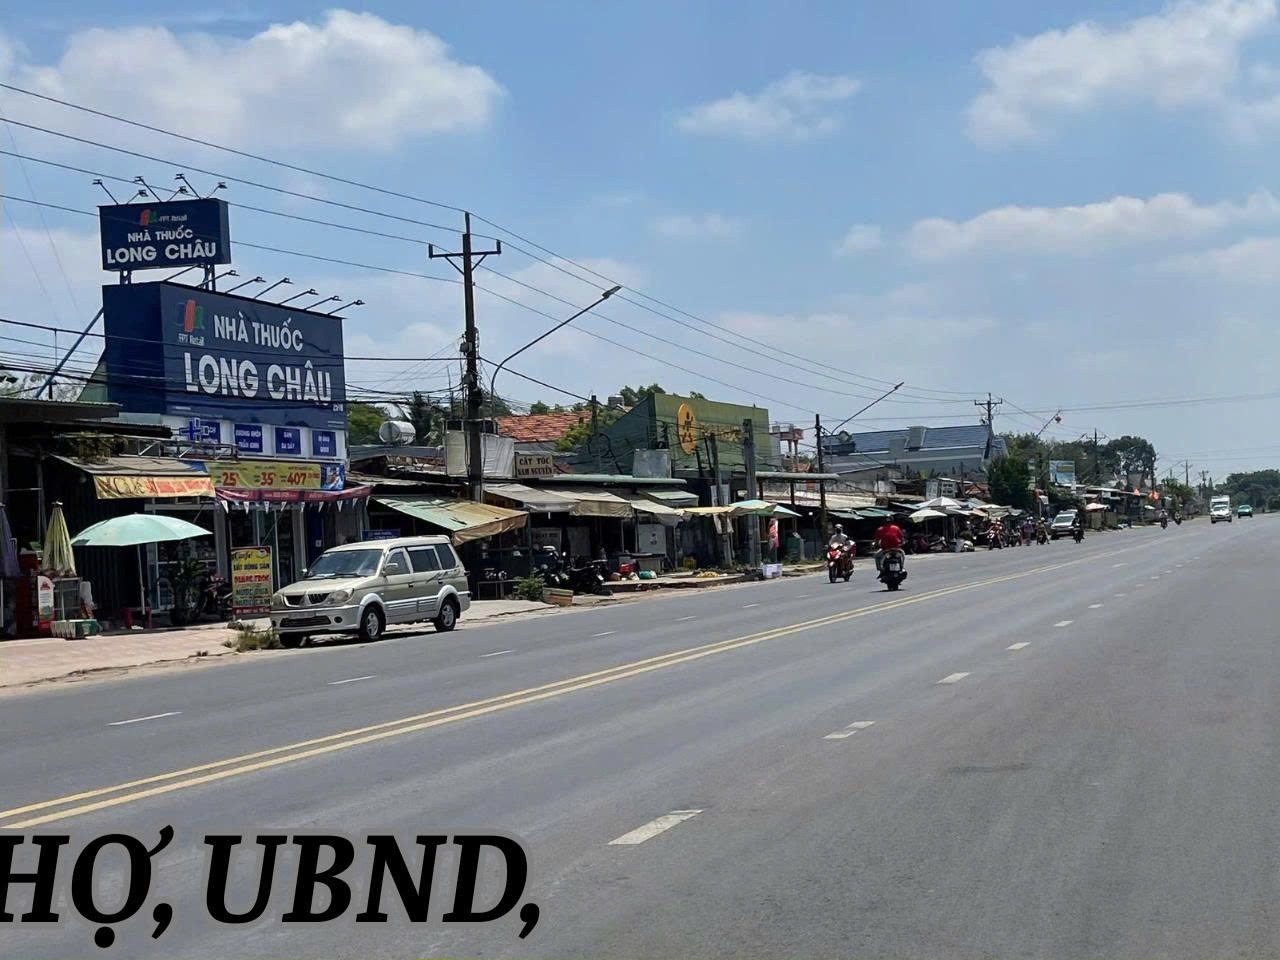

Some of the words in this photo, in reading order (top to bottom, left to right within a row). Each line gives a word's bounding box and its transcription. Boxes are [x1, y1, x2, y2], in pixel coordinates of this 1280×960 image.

[127, 229, 151, 242] NHÀ
[155, 225, 193, 240] THUỐC
[106, 246, 157, 264] LONG
[164, 239, 216, 259] CHÂU
[213, 310, 249, 343] NHÀ
[252, 317, 303, 352] THUỐC
[184, 352, 259, 398] LONG
[267, 359, 332, 406] CHÂU
